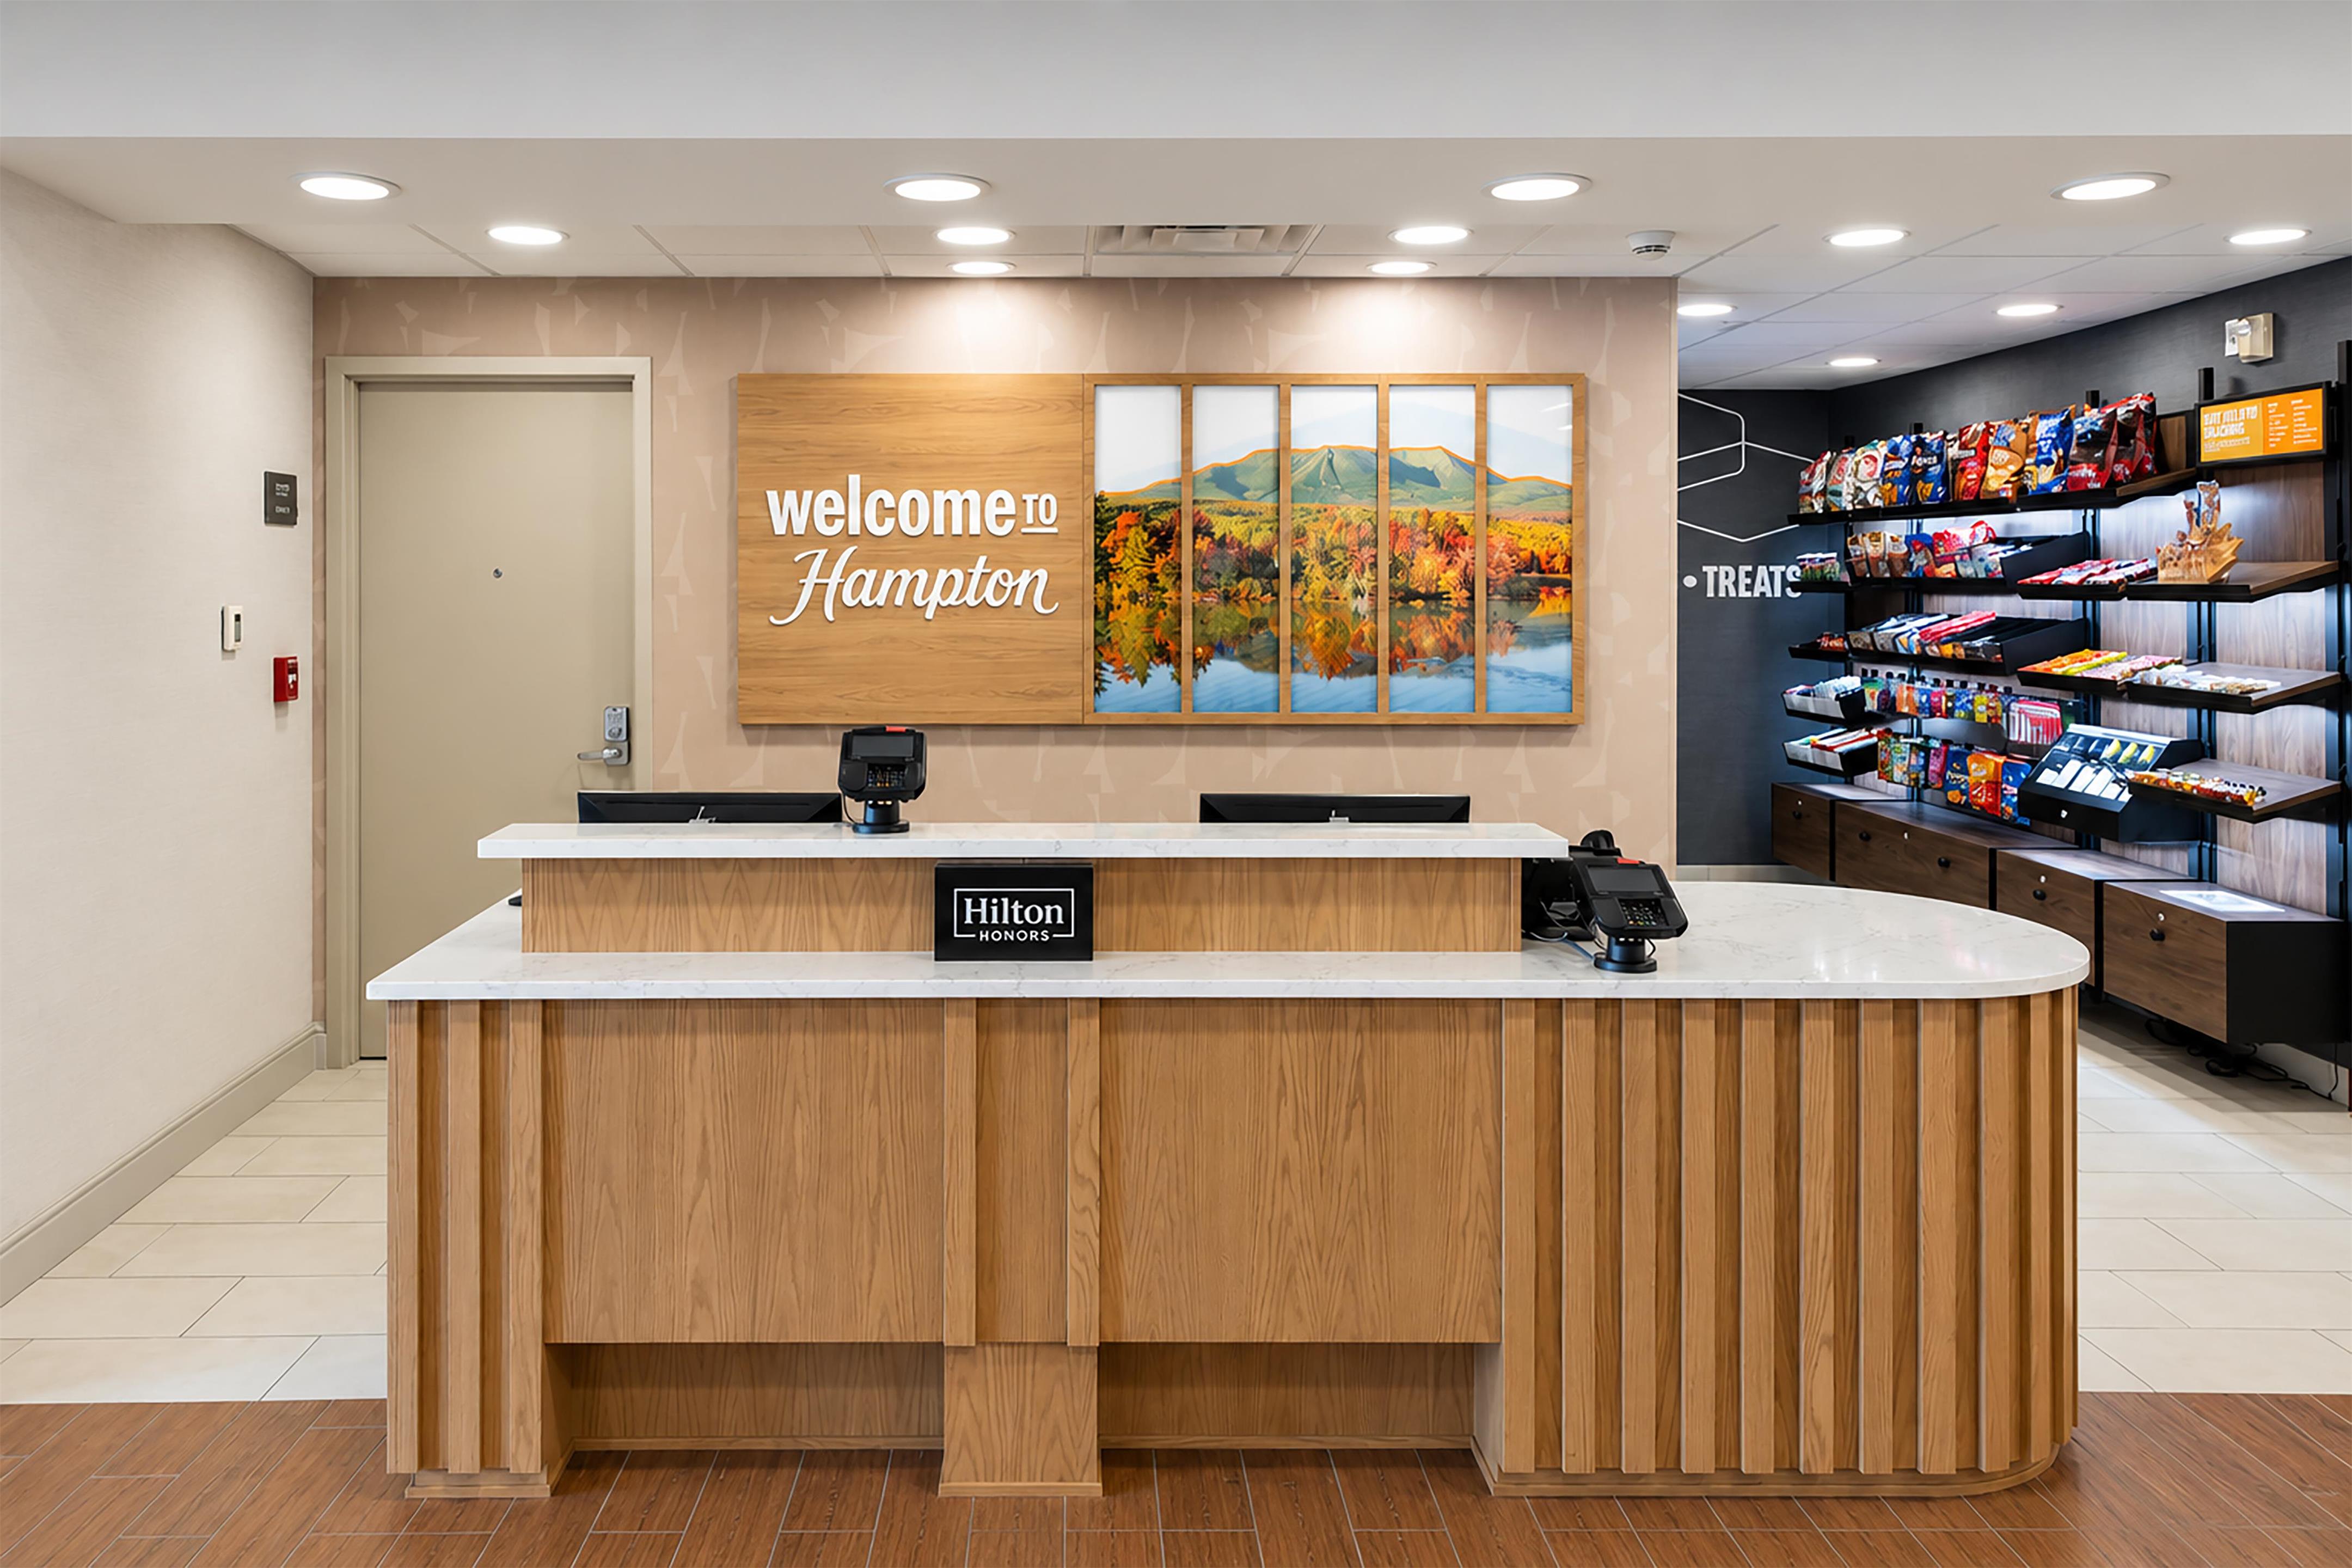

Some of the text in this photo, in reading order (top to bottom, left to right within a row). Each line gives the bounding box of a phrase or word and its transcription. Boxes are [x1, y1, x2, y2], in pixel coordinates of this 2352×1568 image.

[765, 474, 1058, 536] welcome TO
[769, 546, 1059, 625] Hampton
[1702, 565, 1802, 598] TREATS
[964, 897, 1064, 924] Hilton
[979, 929, 1050, 942] HONORS
